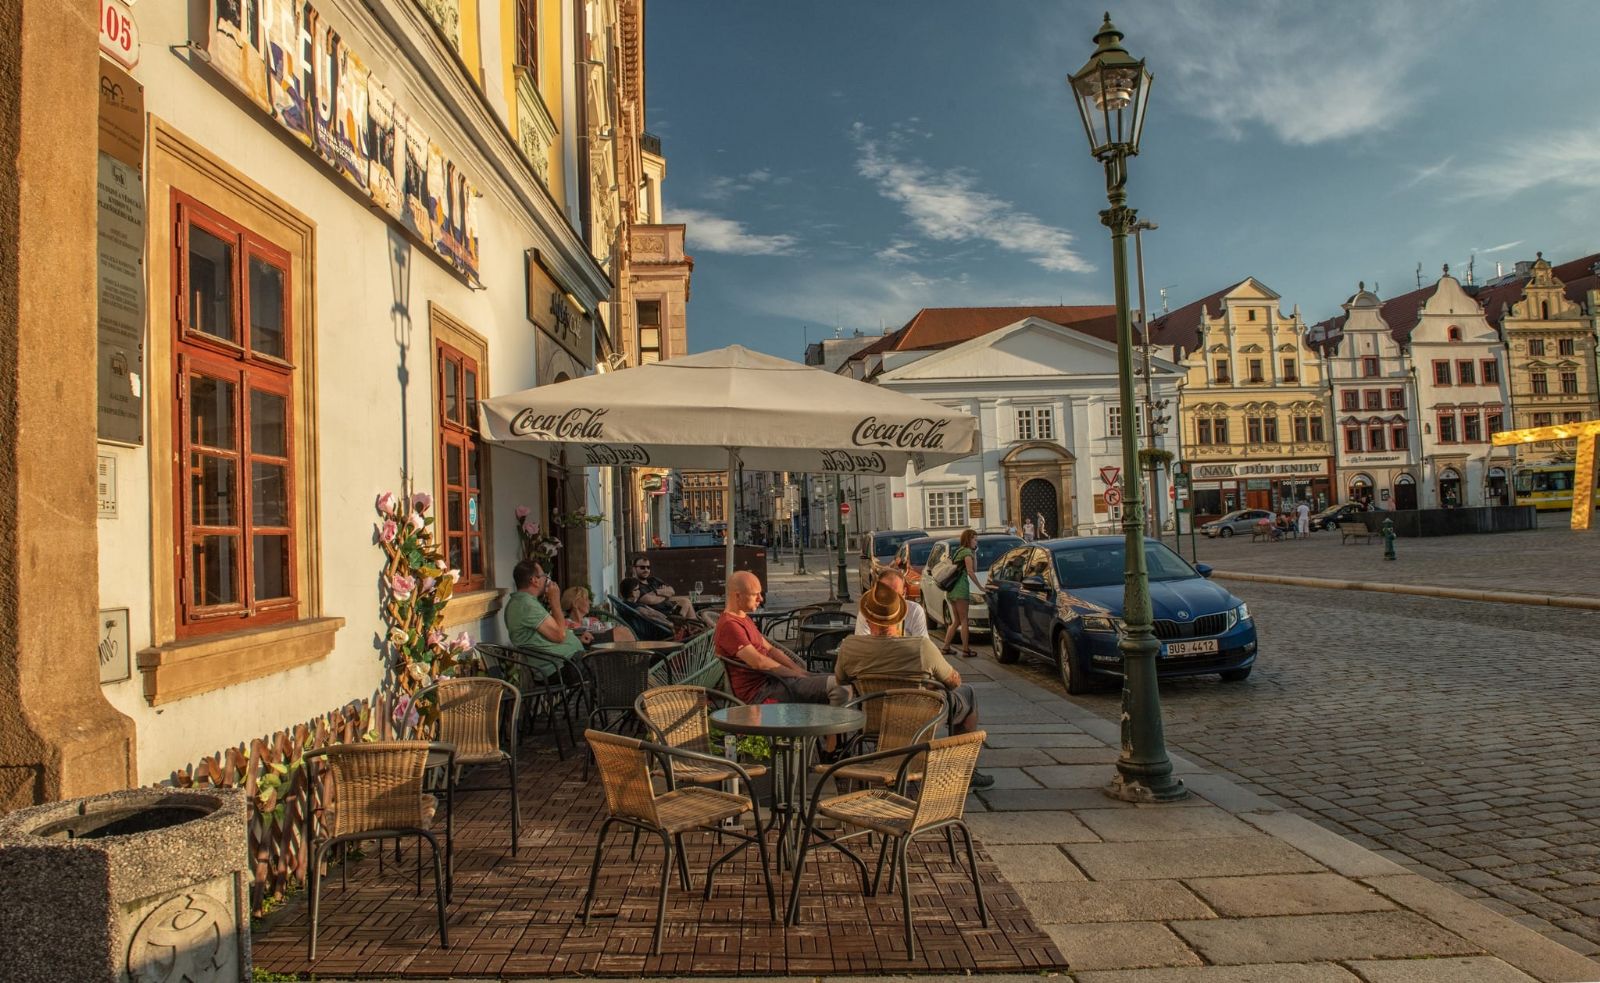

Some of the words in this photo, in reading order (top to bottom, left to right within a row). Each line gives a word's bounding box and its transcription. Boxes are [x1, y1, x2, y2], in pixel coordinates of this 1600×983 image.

[509, 407, 610, 438] Coca-Cola
[851, 416, 952, 449] Coca-Cola
[1280, 462, 1322, 473] KNIHY
[1192, 641, 1214, 652] 4412
